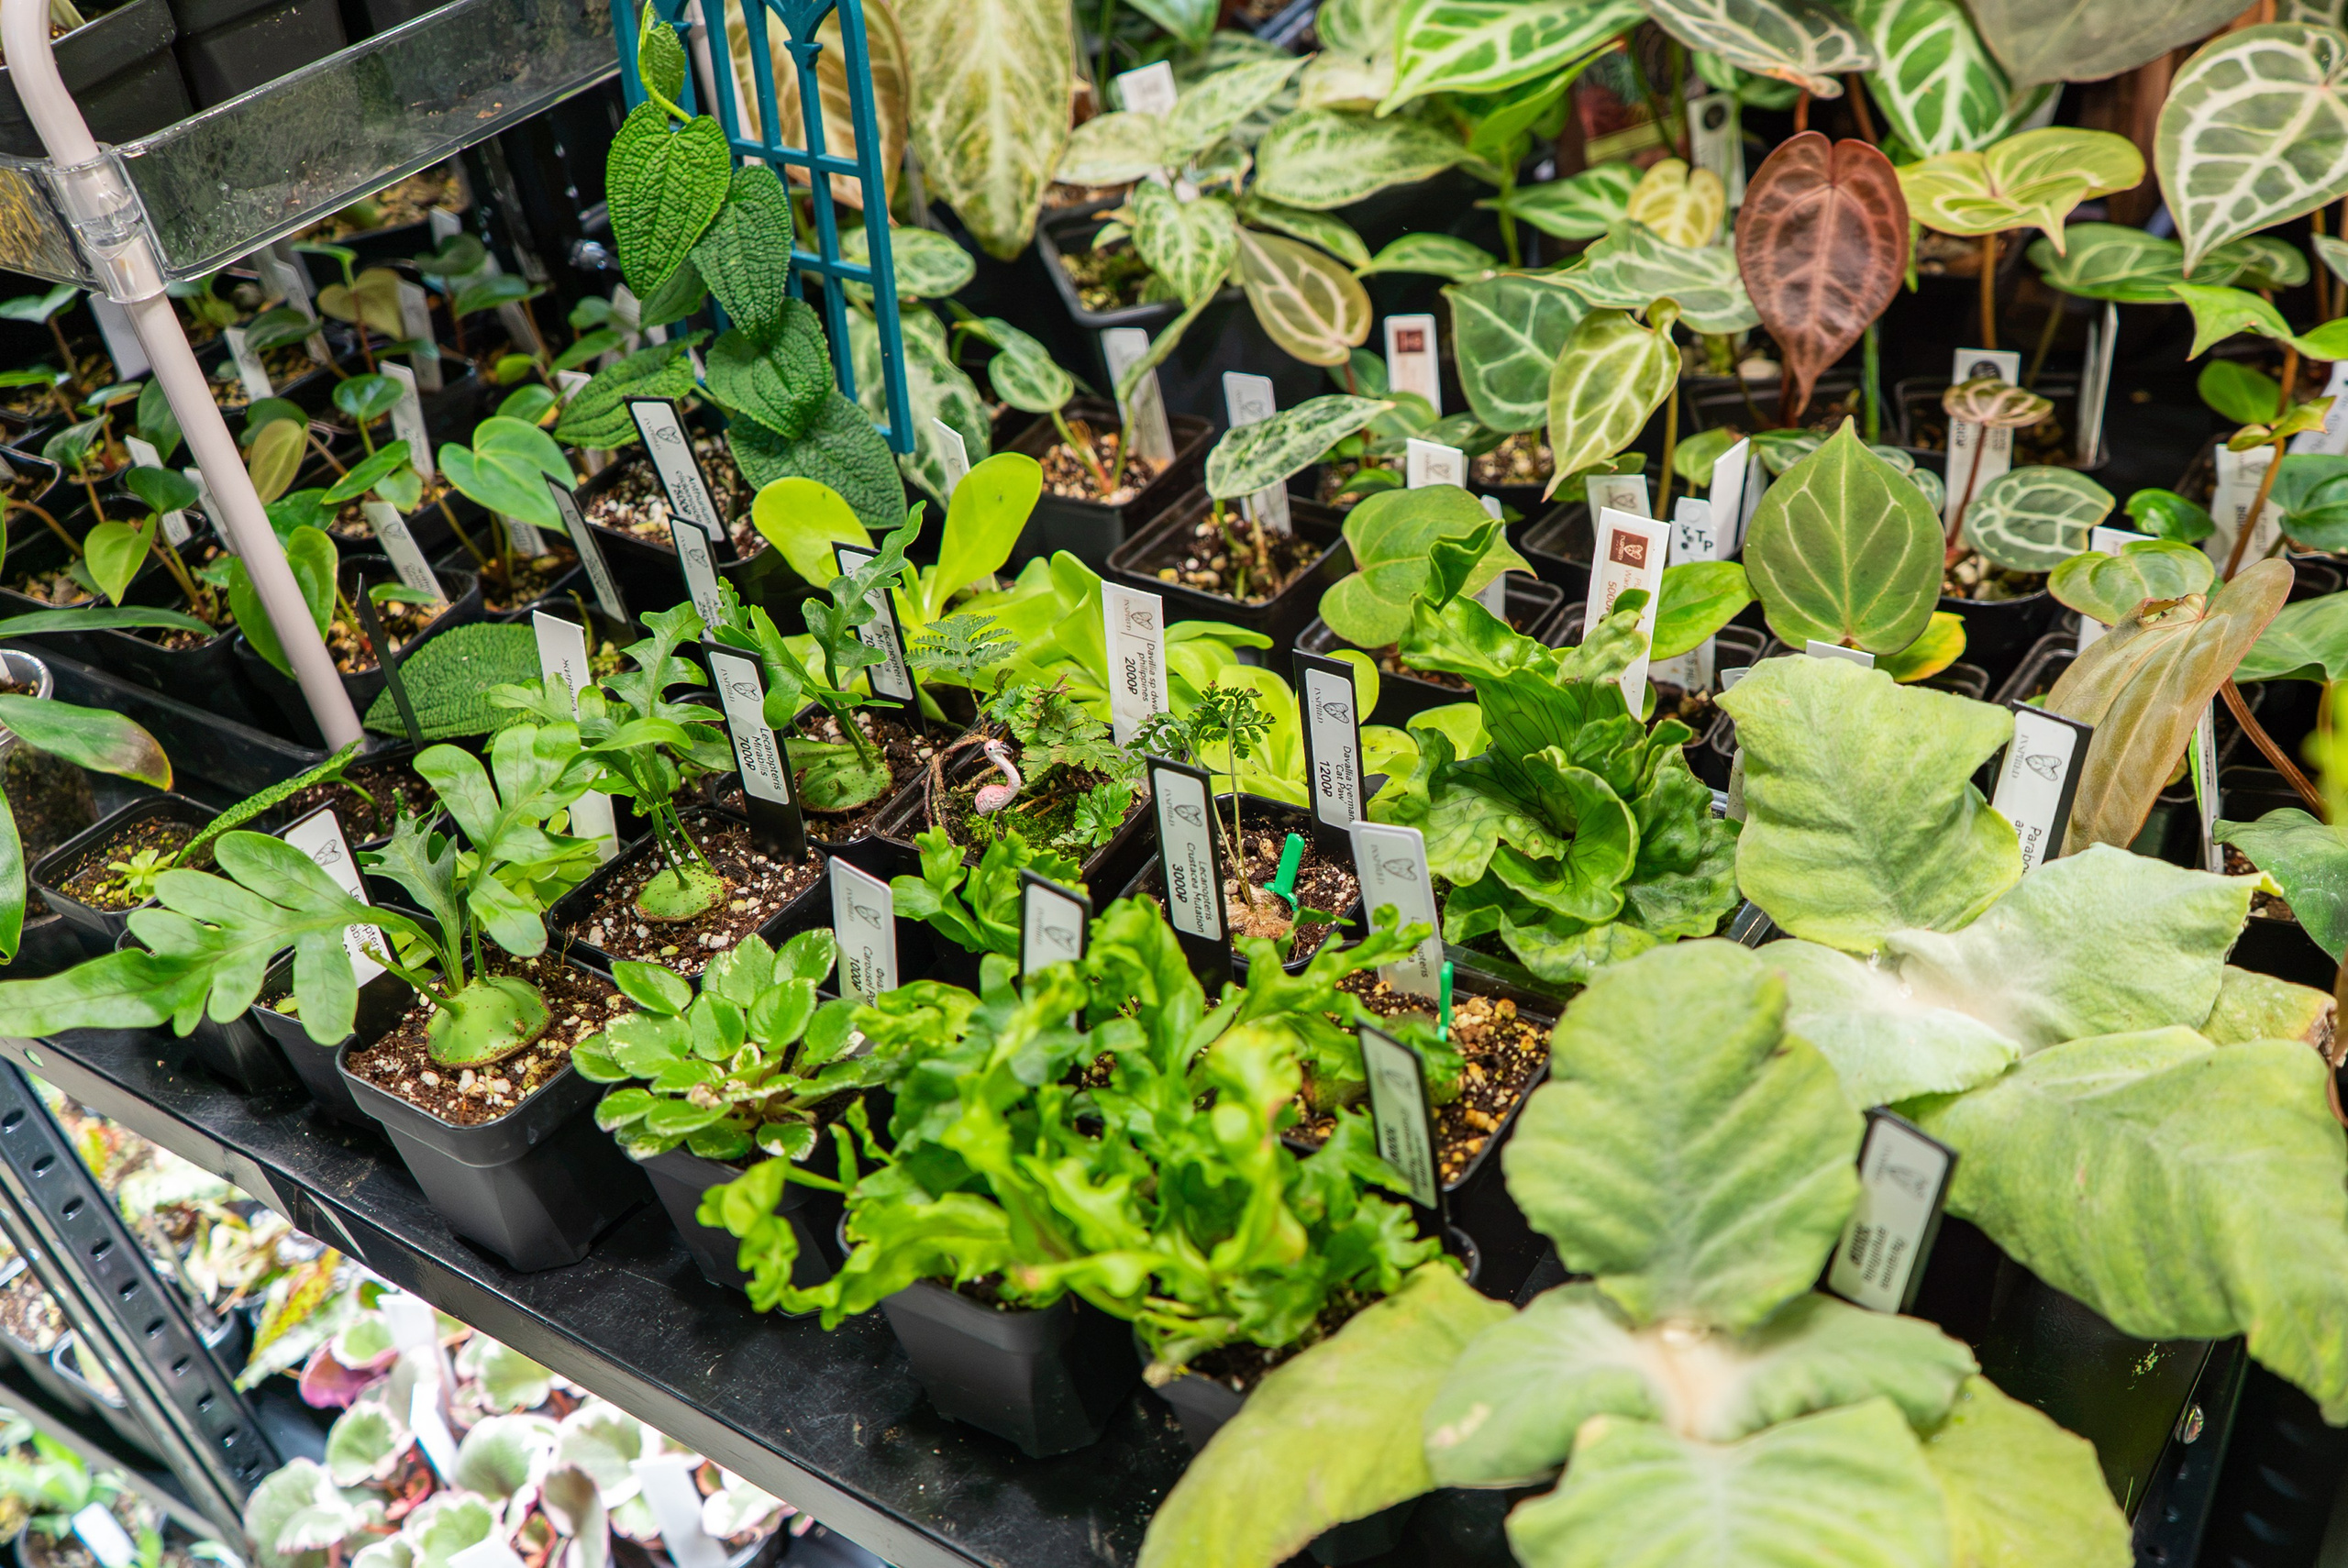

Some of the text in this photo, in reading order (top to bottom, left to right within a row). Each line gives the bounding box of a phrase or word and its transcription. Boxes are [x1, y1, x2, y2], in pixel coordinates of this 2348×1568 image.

[1605, 580, 1617, 612] 5000
[881, 624, 903, 687] Lecanopteris
[1136, 651, 1148, 702] philippines
[1147, 677, 1157, 690] sp
[1150, 690, 1159, 713] dwar
[1313, 687, 1324, 724] INSPIRED
[751, 736, 769, 778] Mirabilis
[759, 726, 781, 791] Lecanopteris
[1343, 745, 1354, 780] Davallia
[2011, 734, 2030, 779] INSPIRED
[1187, 842, 1204, 933] Crustacea Mutation
[1199, 861, 1213, 922] Lecanopteris
[863, 945, 873, 990] Carousel
